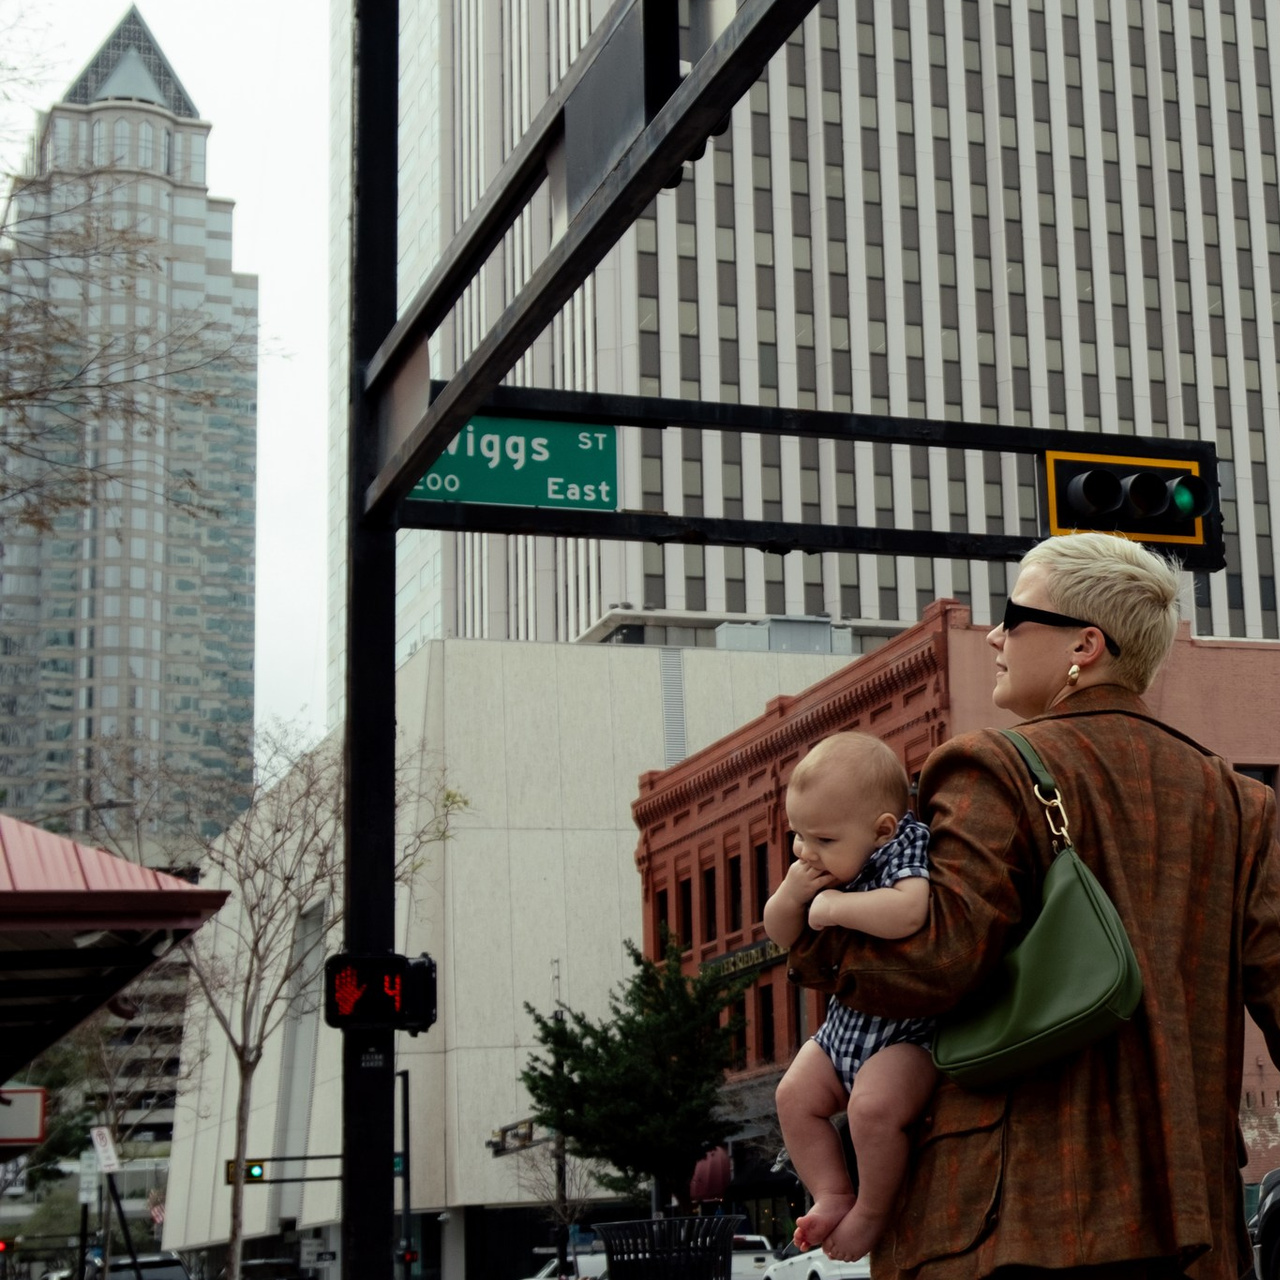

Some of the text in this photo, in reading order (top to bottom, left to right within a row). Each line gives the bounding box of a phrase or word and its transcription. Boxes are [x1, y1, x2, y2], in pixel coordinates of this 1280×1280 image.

[578, 432, 606, 451] ST
[547, 477, 610, 502] East
[383, 972, 403, 1014] 4
